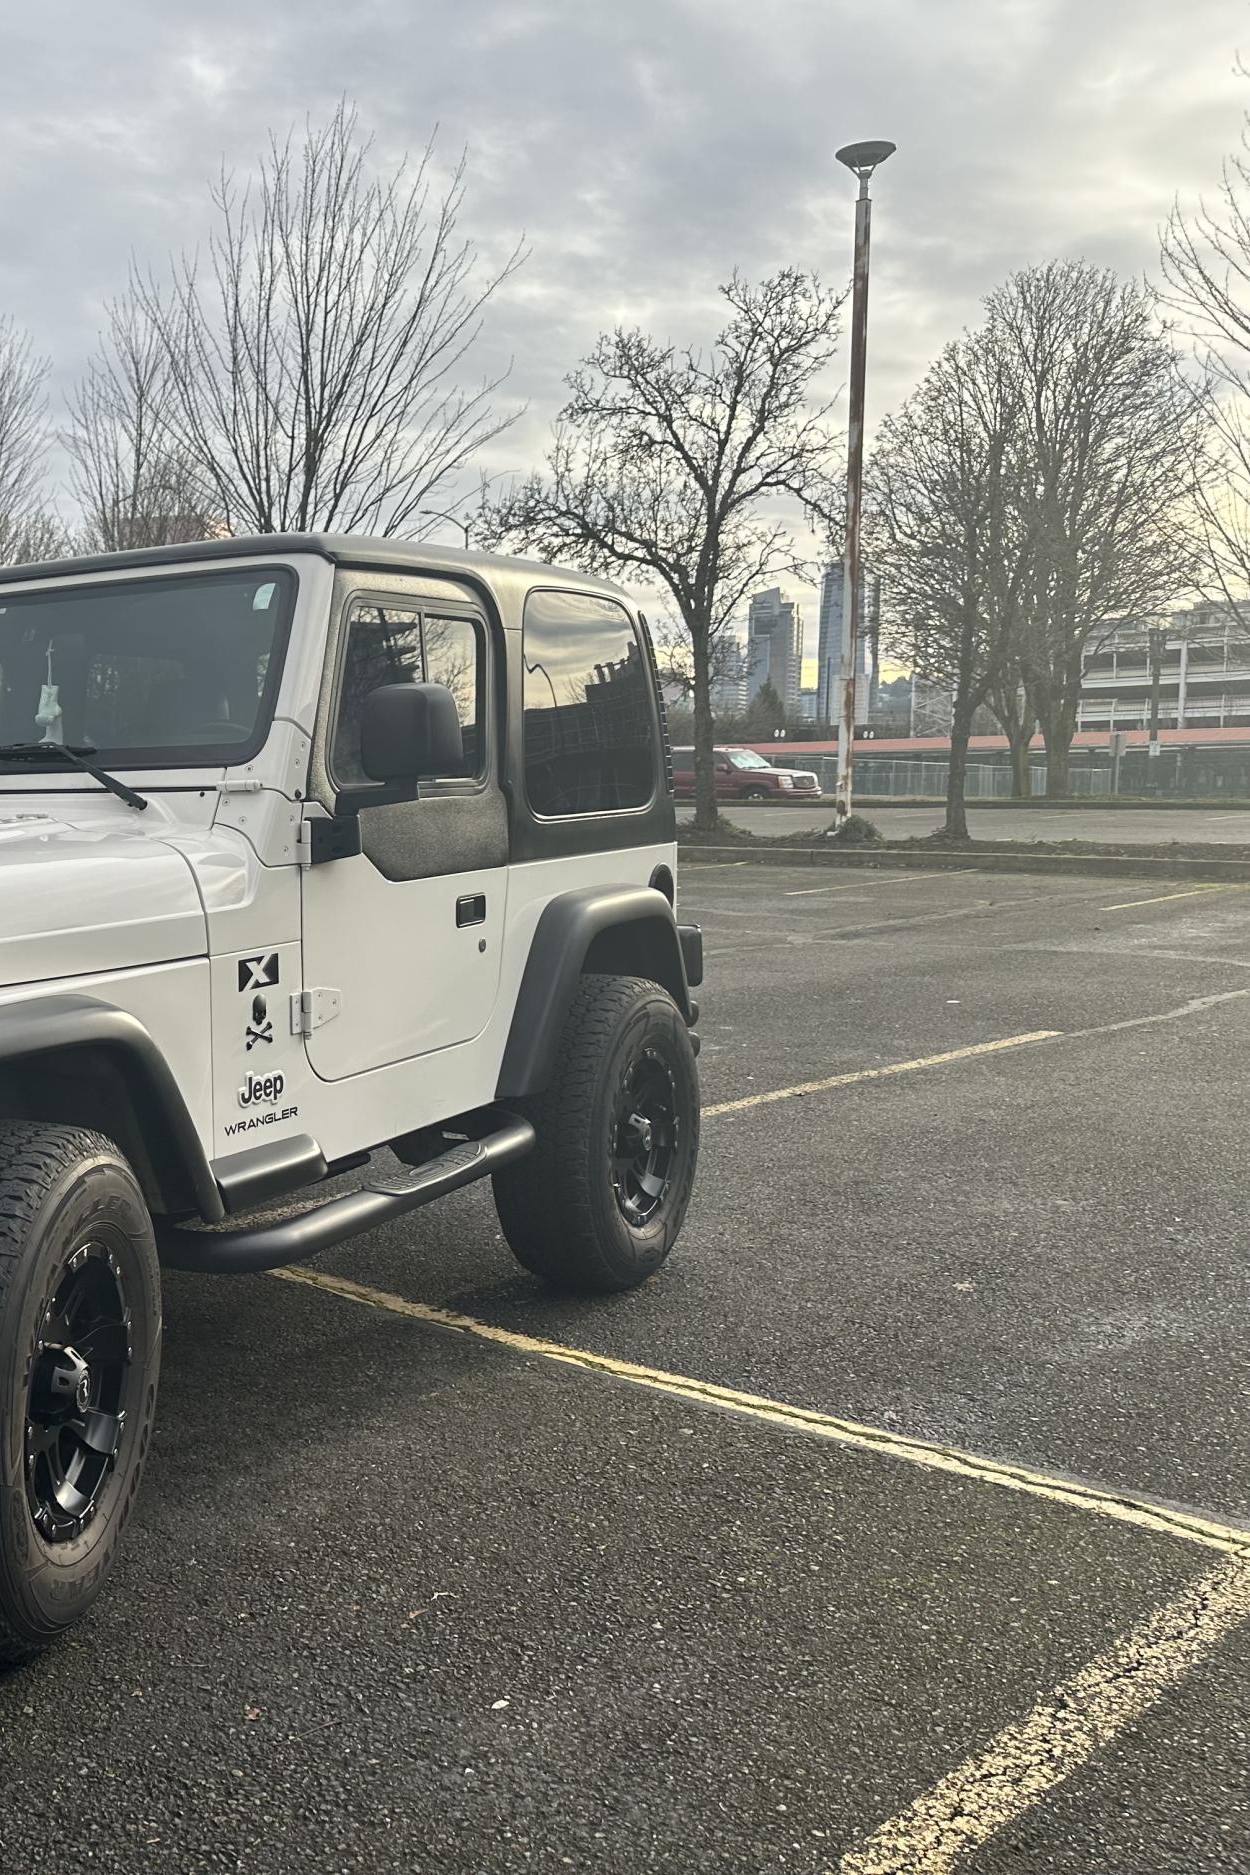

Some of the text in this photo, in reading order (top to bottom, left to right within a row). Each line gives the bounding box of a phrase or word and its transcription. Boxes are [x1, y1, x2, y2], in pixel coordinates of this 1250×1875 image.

[239, 953, 279, 991] X
[240, 1073, 284, 1105] Jeep
[224, 1106, 298, 1136] WRANGLER
